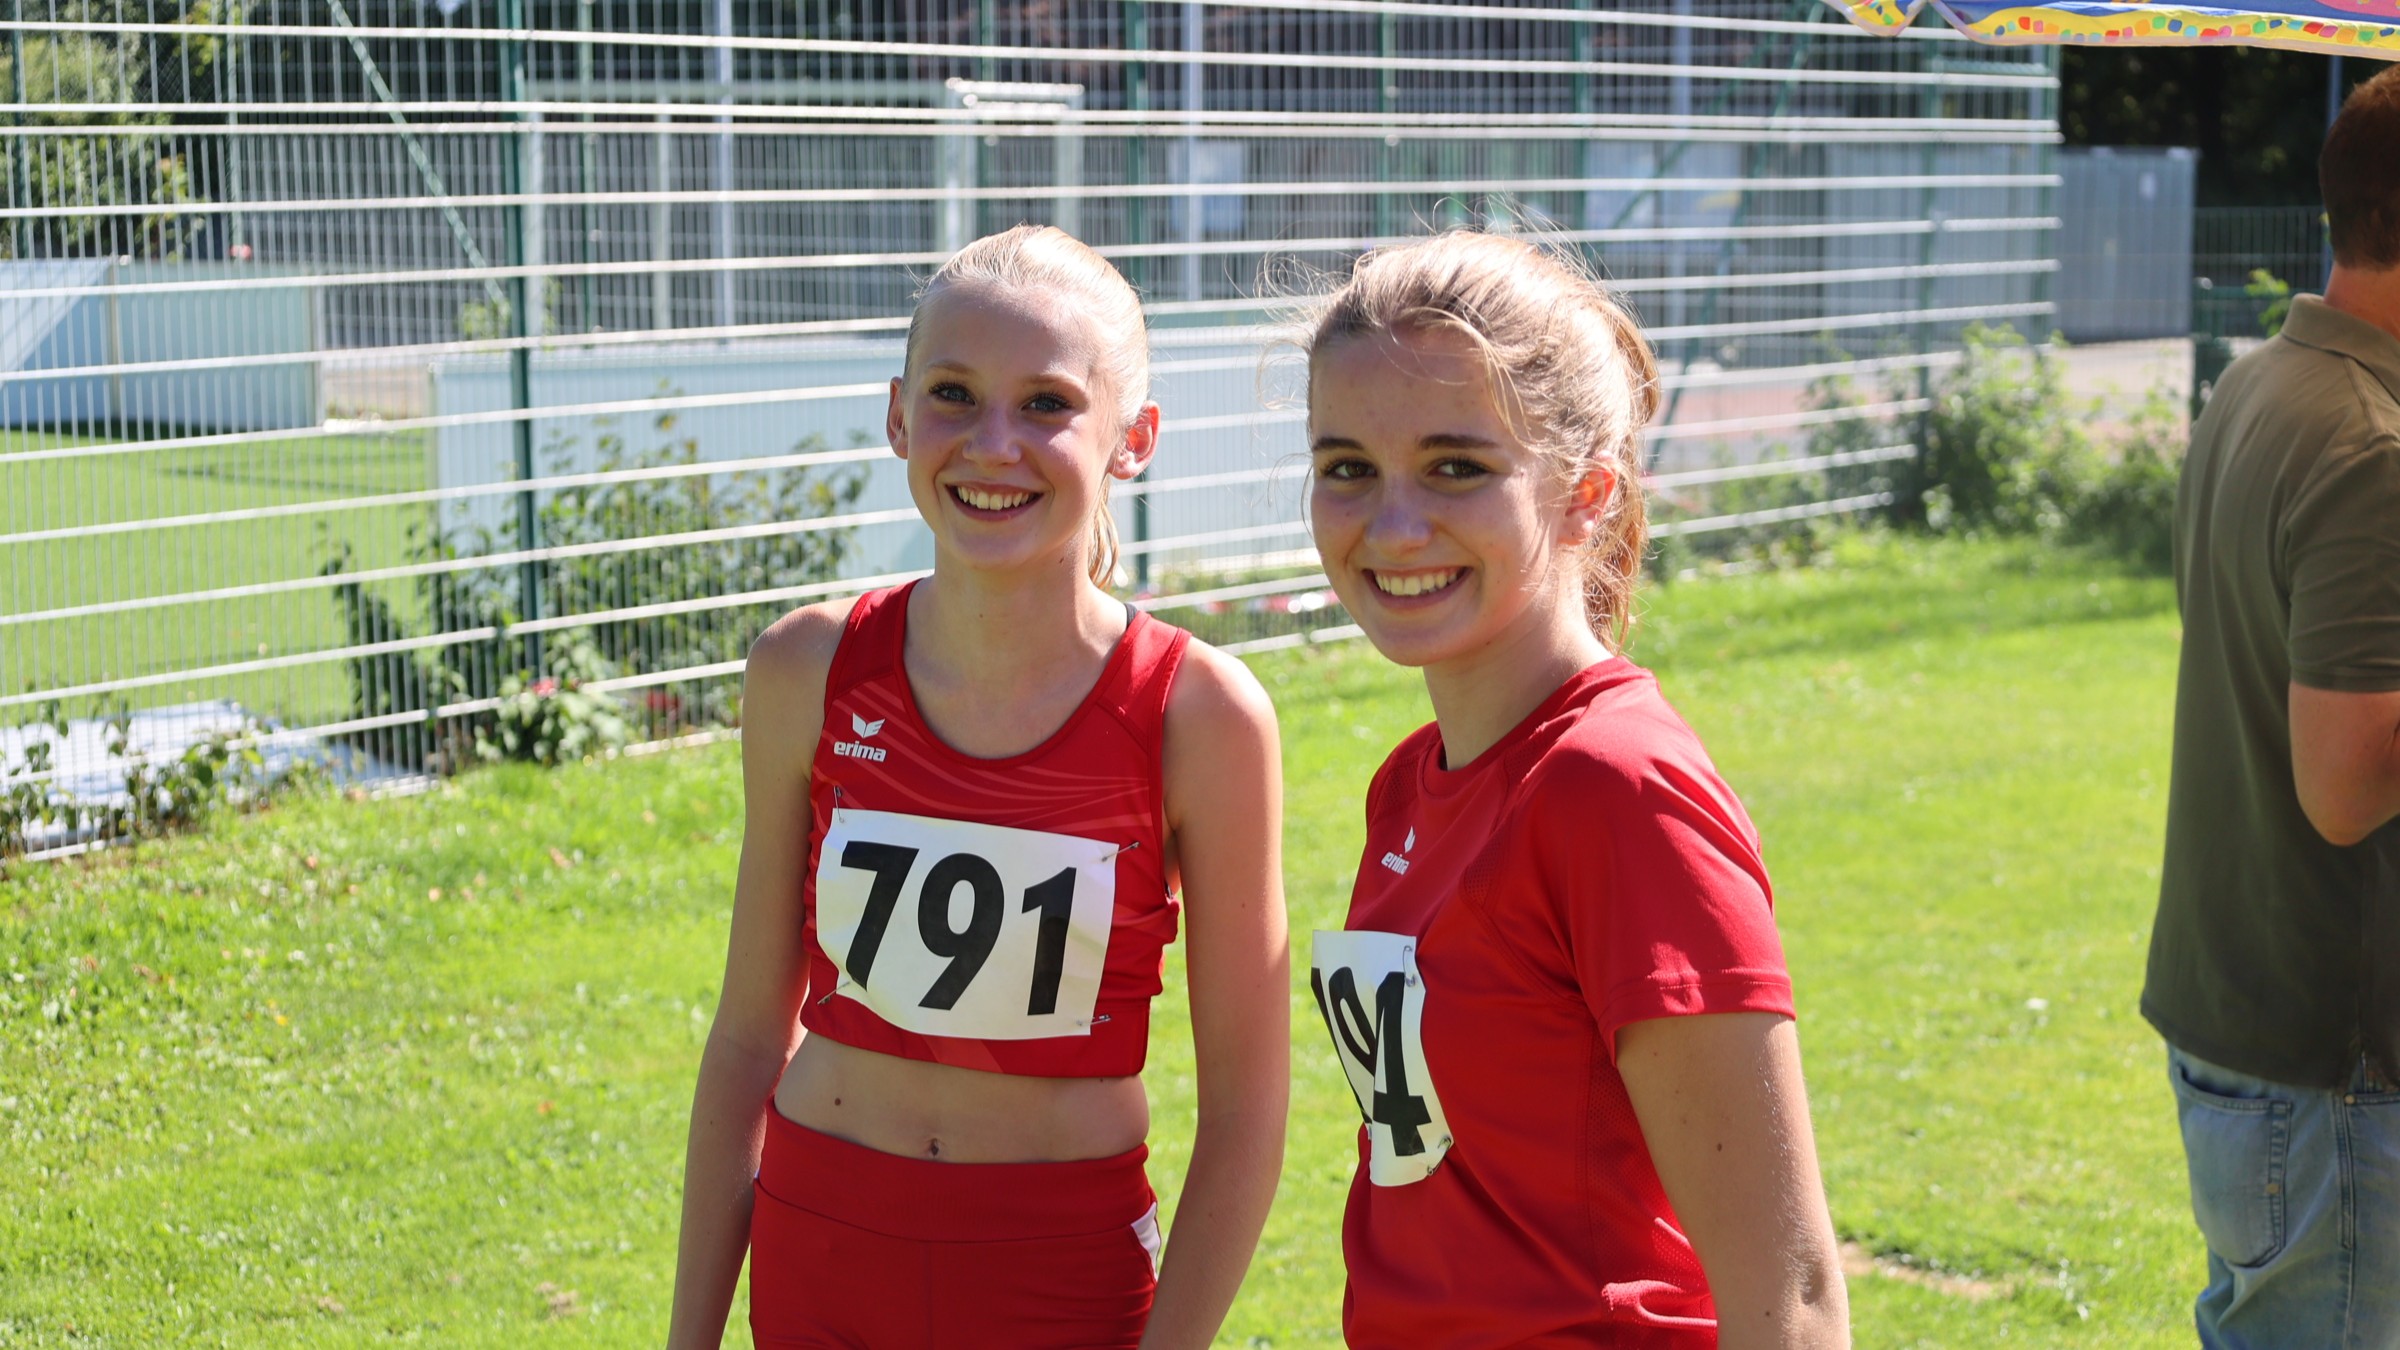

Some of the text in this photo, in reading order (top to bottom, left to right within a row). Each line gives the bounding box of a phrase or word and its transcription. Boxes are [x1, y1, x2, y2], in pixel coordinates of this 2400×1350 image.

[833, 740, 887, 763] erima
[1381, 851, 1410, 875] erima
[841, 840, 1077, 1016] 791
